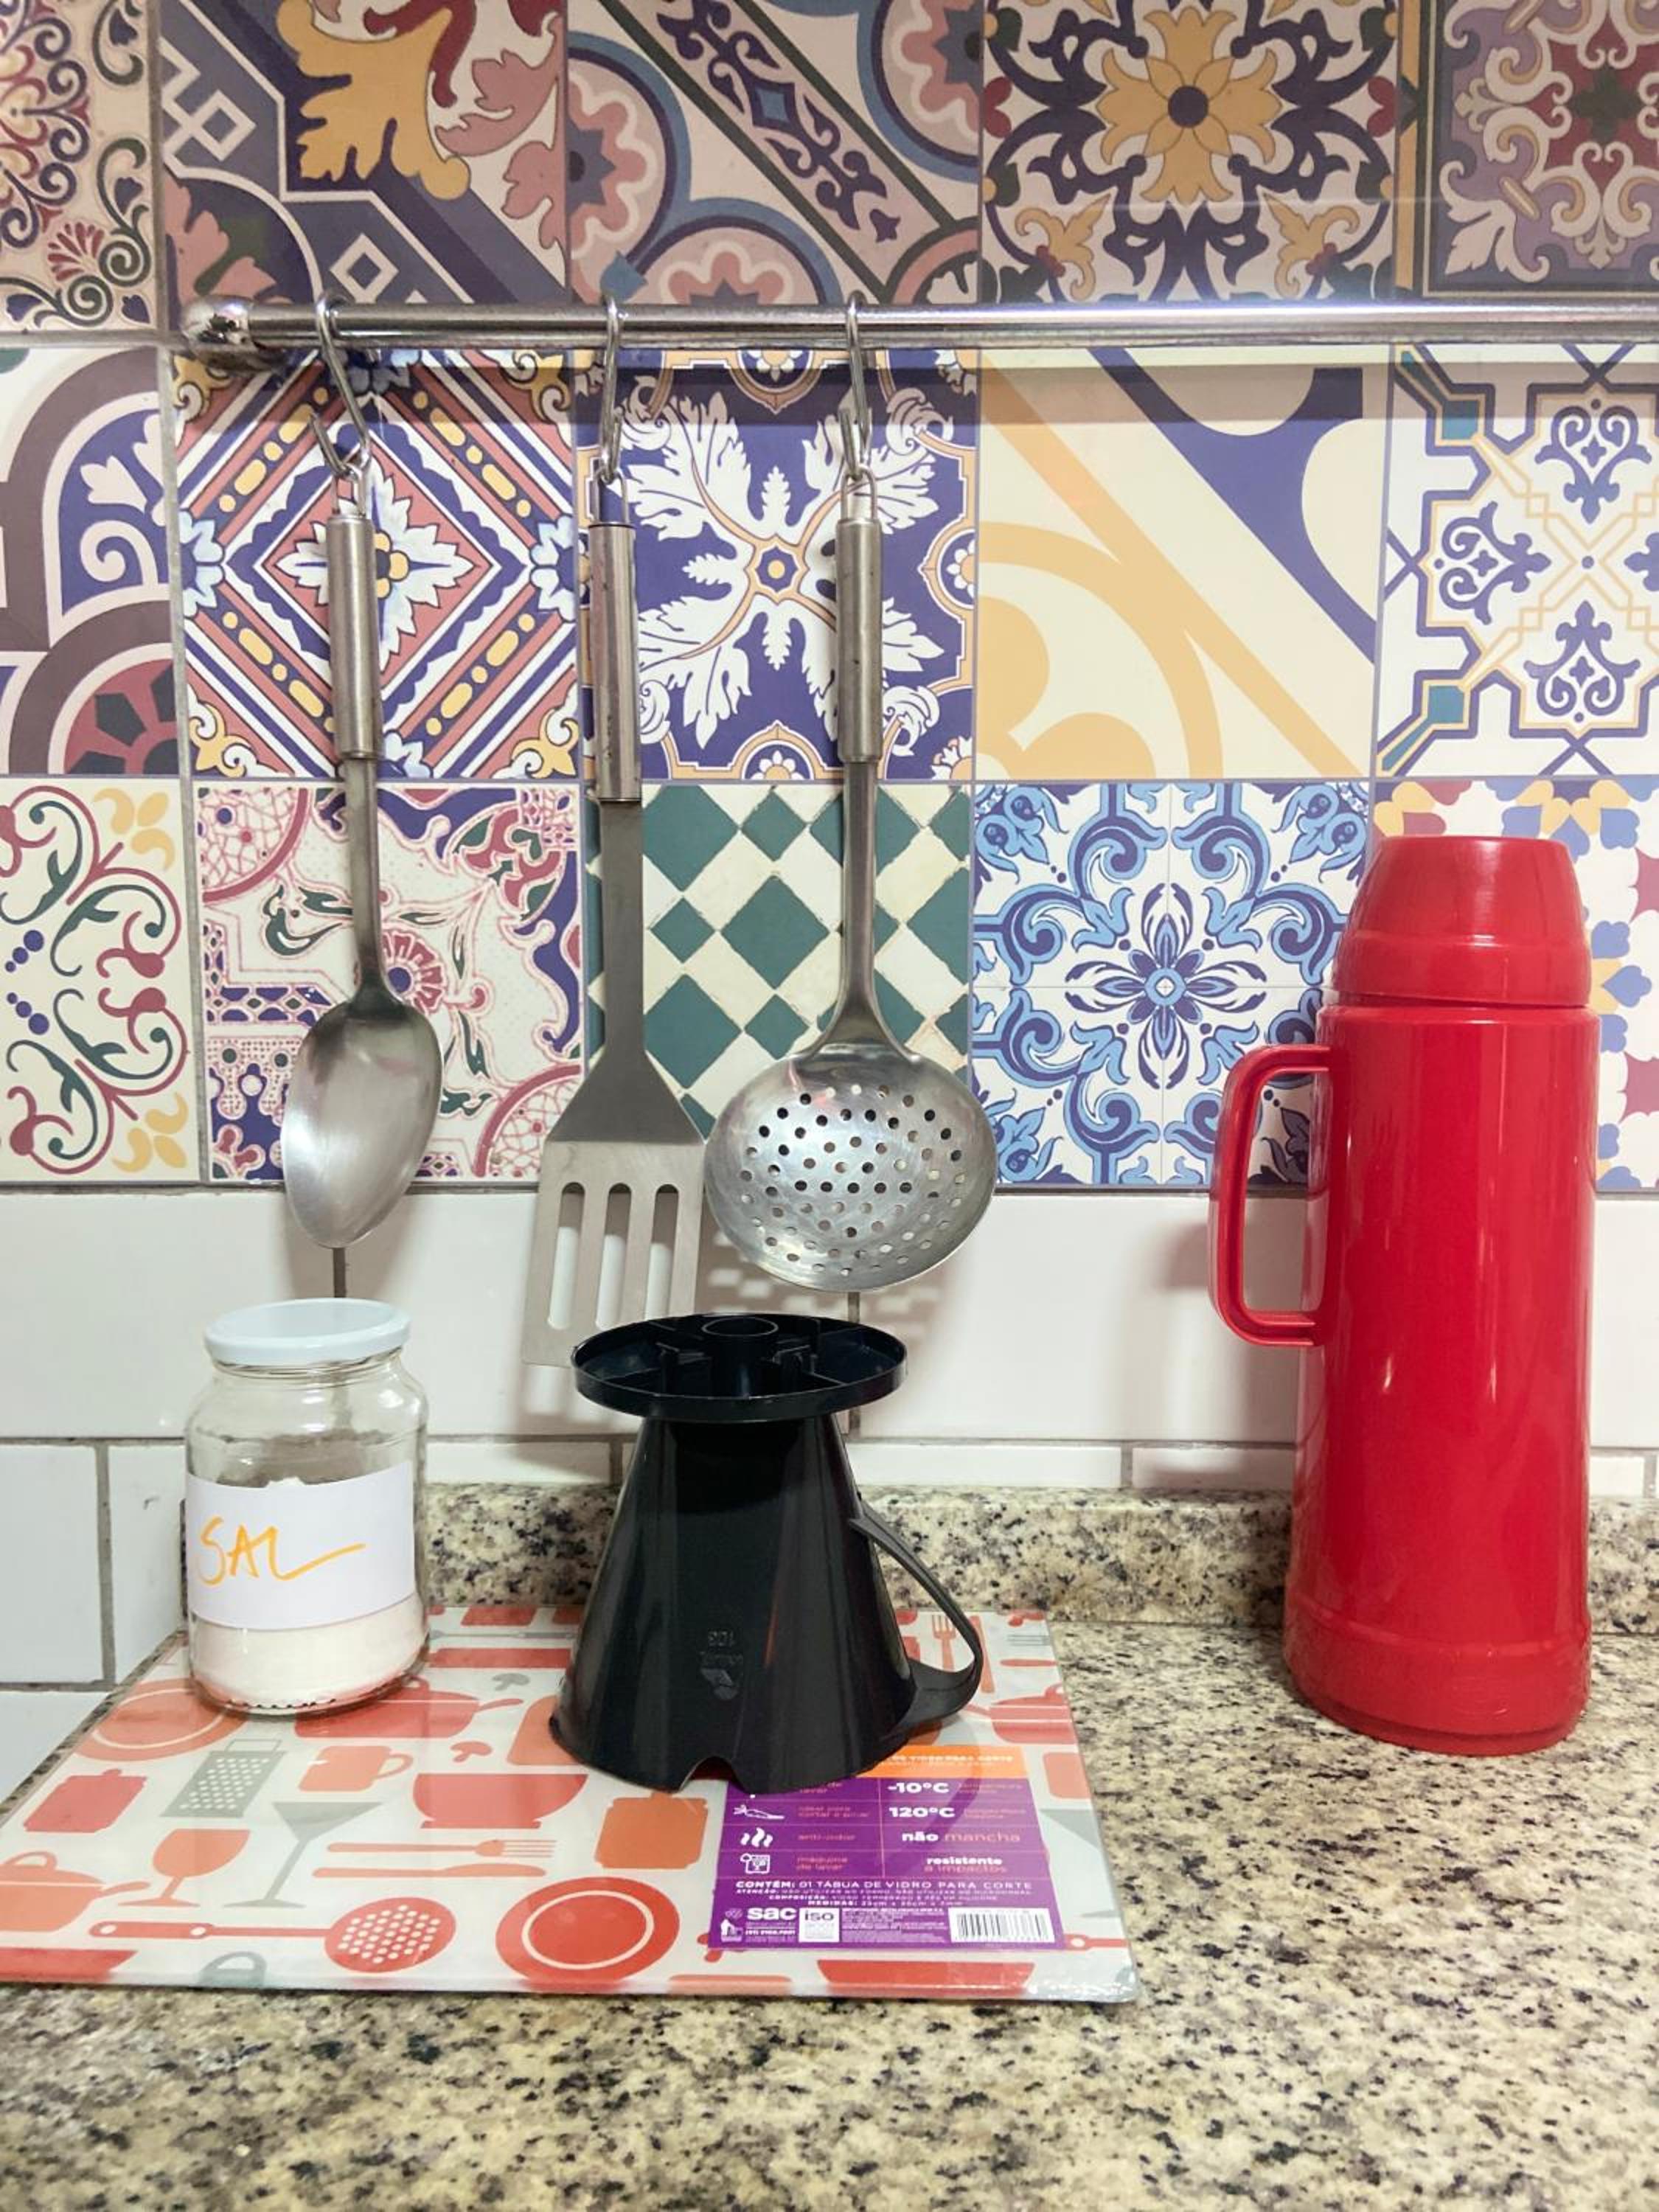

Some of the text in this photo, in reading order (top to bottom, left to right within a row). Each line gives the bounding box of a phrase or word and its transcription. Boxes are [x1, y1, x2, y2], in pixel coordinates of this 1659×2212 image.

[198, 1516, 366, 1585] SAL
[902, 1831, 1020, 1842] não mancha
[927, 1856, 1003, 1865] resistente
[735, 1879, 796, 1888] CONTÉM:
[816, 1879, 860, 1888] TÁBUA
[983, 1881, 1032, 1889] CORTE
[747, 1907, 796, 1921] sac
